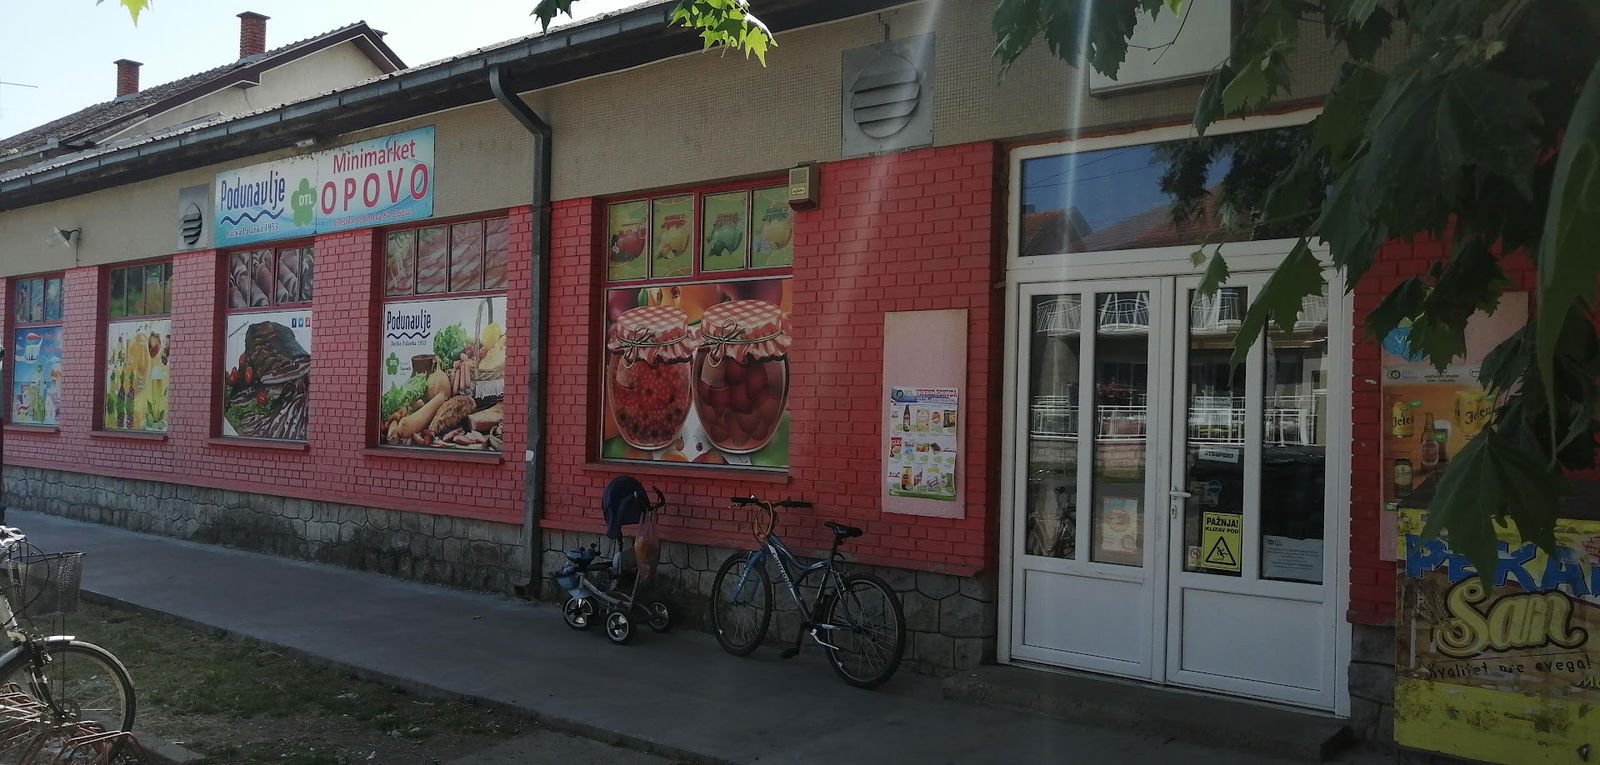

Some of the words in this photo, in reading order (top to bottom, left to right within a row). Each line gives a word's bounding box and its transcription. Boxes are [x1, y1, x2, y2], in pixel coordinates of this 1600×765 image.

[333, 139, 416, 174] Minimarket
[221, 170, 286, 211] Podunavlje
[299, 193, 313, 206] DTL
[321, 163, 429, 215] OPOVO
[386, 309, 431, 333] Podunavlje
[1206, 516, 1239, 528] PAŽNJA!
